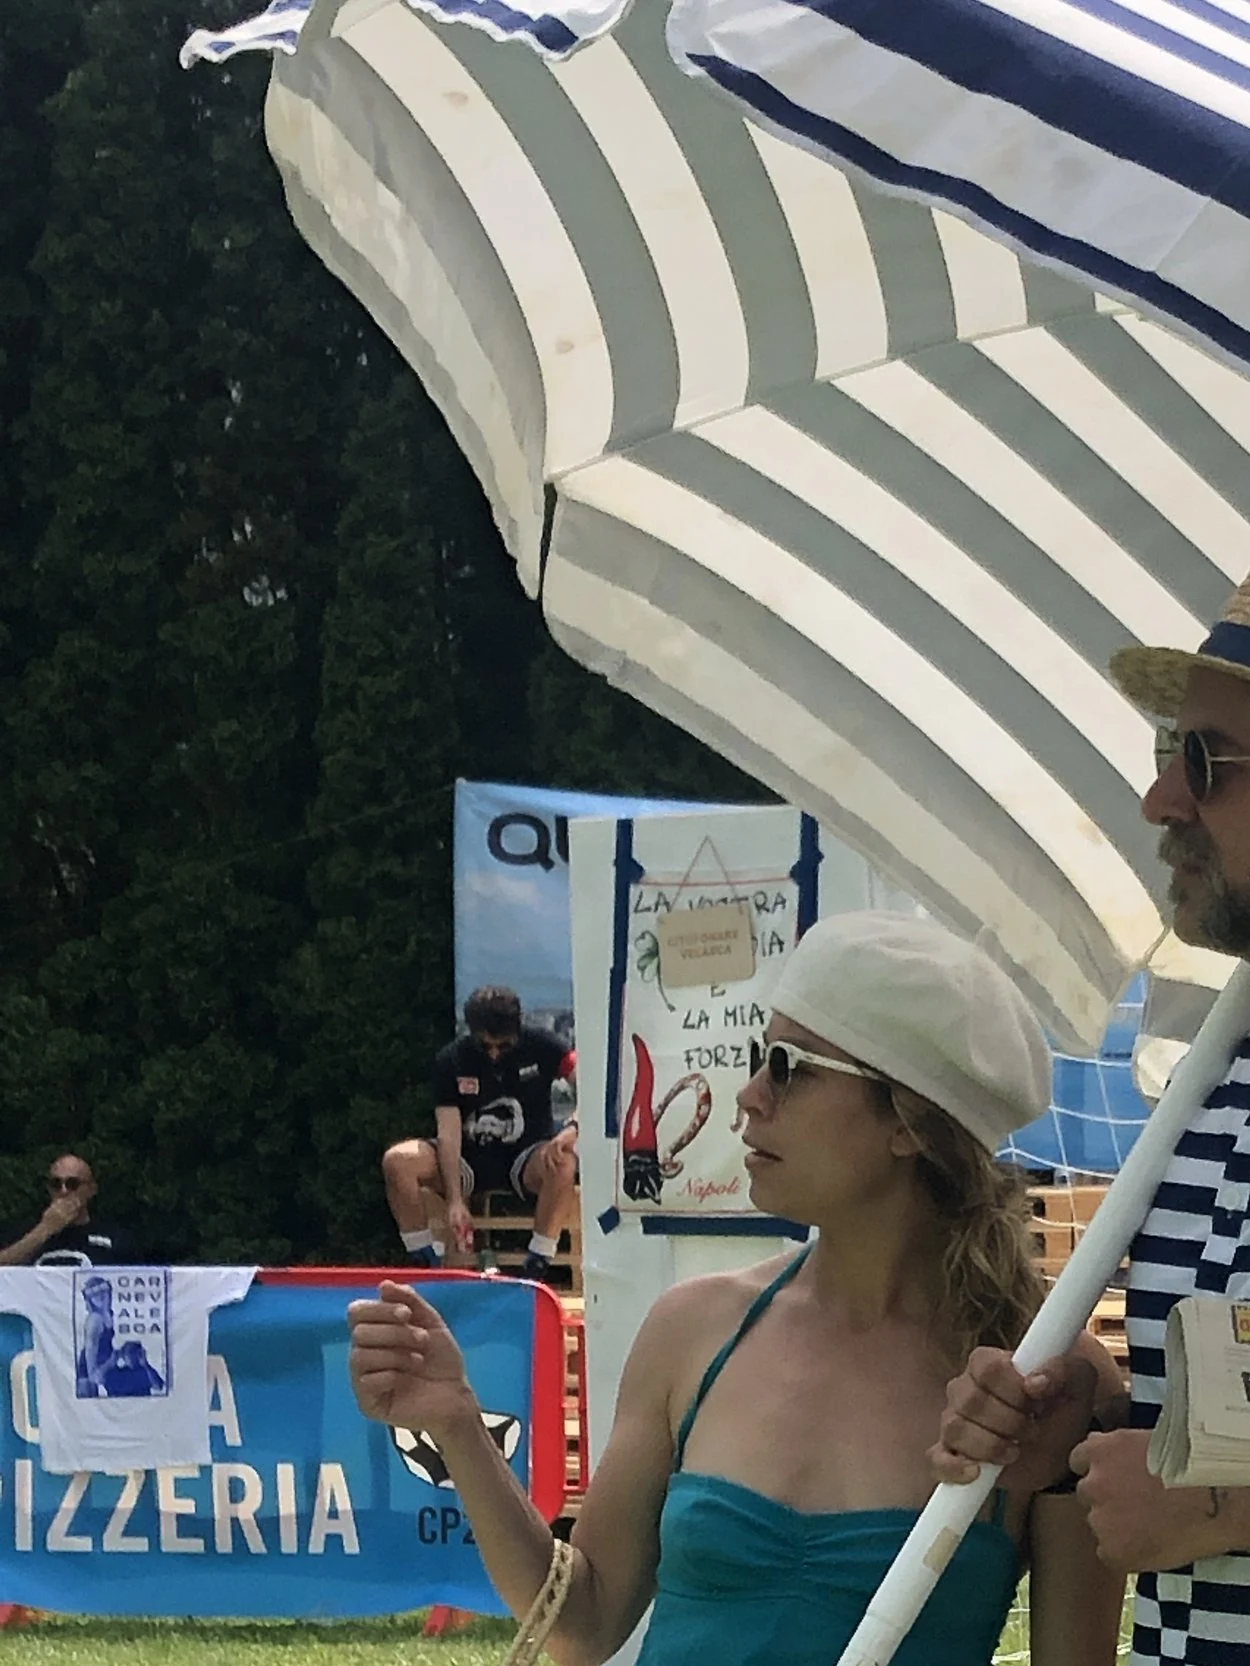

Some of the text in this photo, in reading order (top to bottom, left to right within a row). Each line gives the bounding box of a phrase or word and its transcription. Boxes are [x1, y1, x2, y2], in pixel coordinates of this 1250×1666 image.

[633, 891, 671, 914] LA
[682, 1001, 765, 1030] LA MIA
[684, 1043, 749, 1070] FORZ
[117, 1275, 161, 1287] CAR
[117, 1291, 161, 1303] NEV
[117, 1307, 161, 1319] ALE
[0, 1458, 361, 1555] IZZERIA
